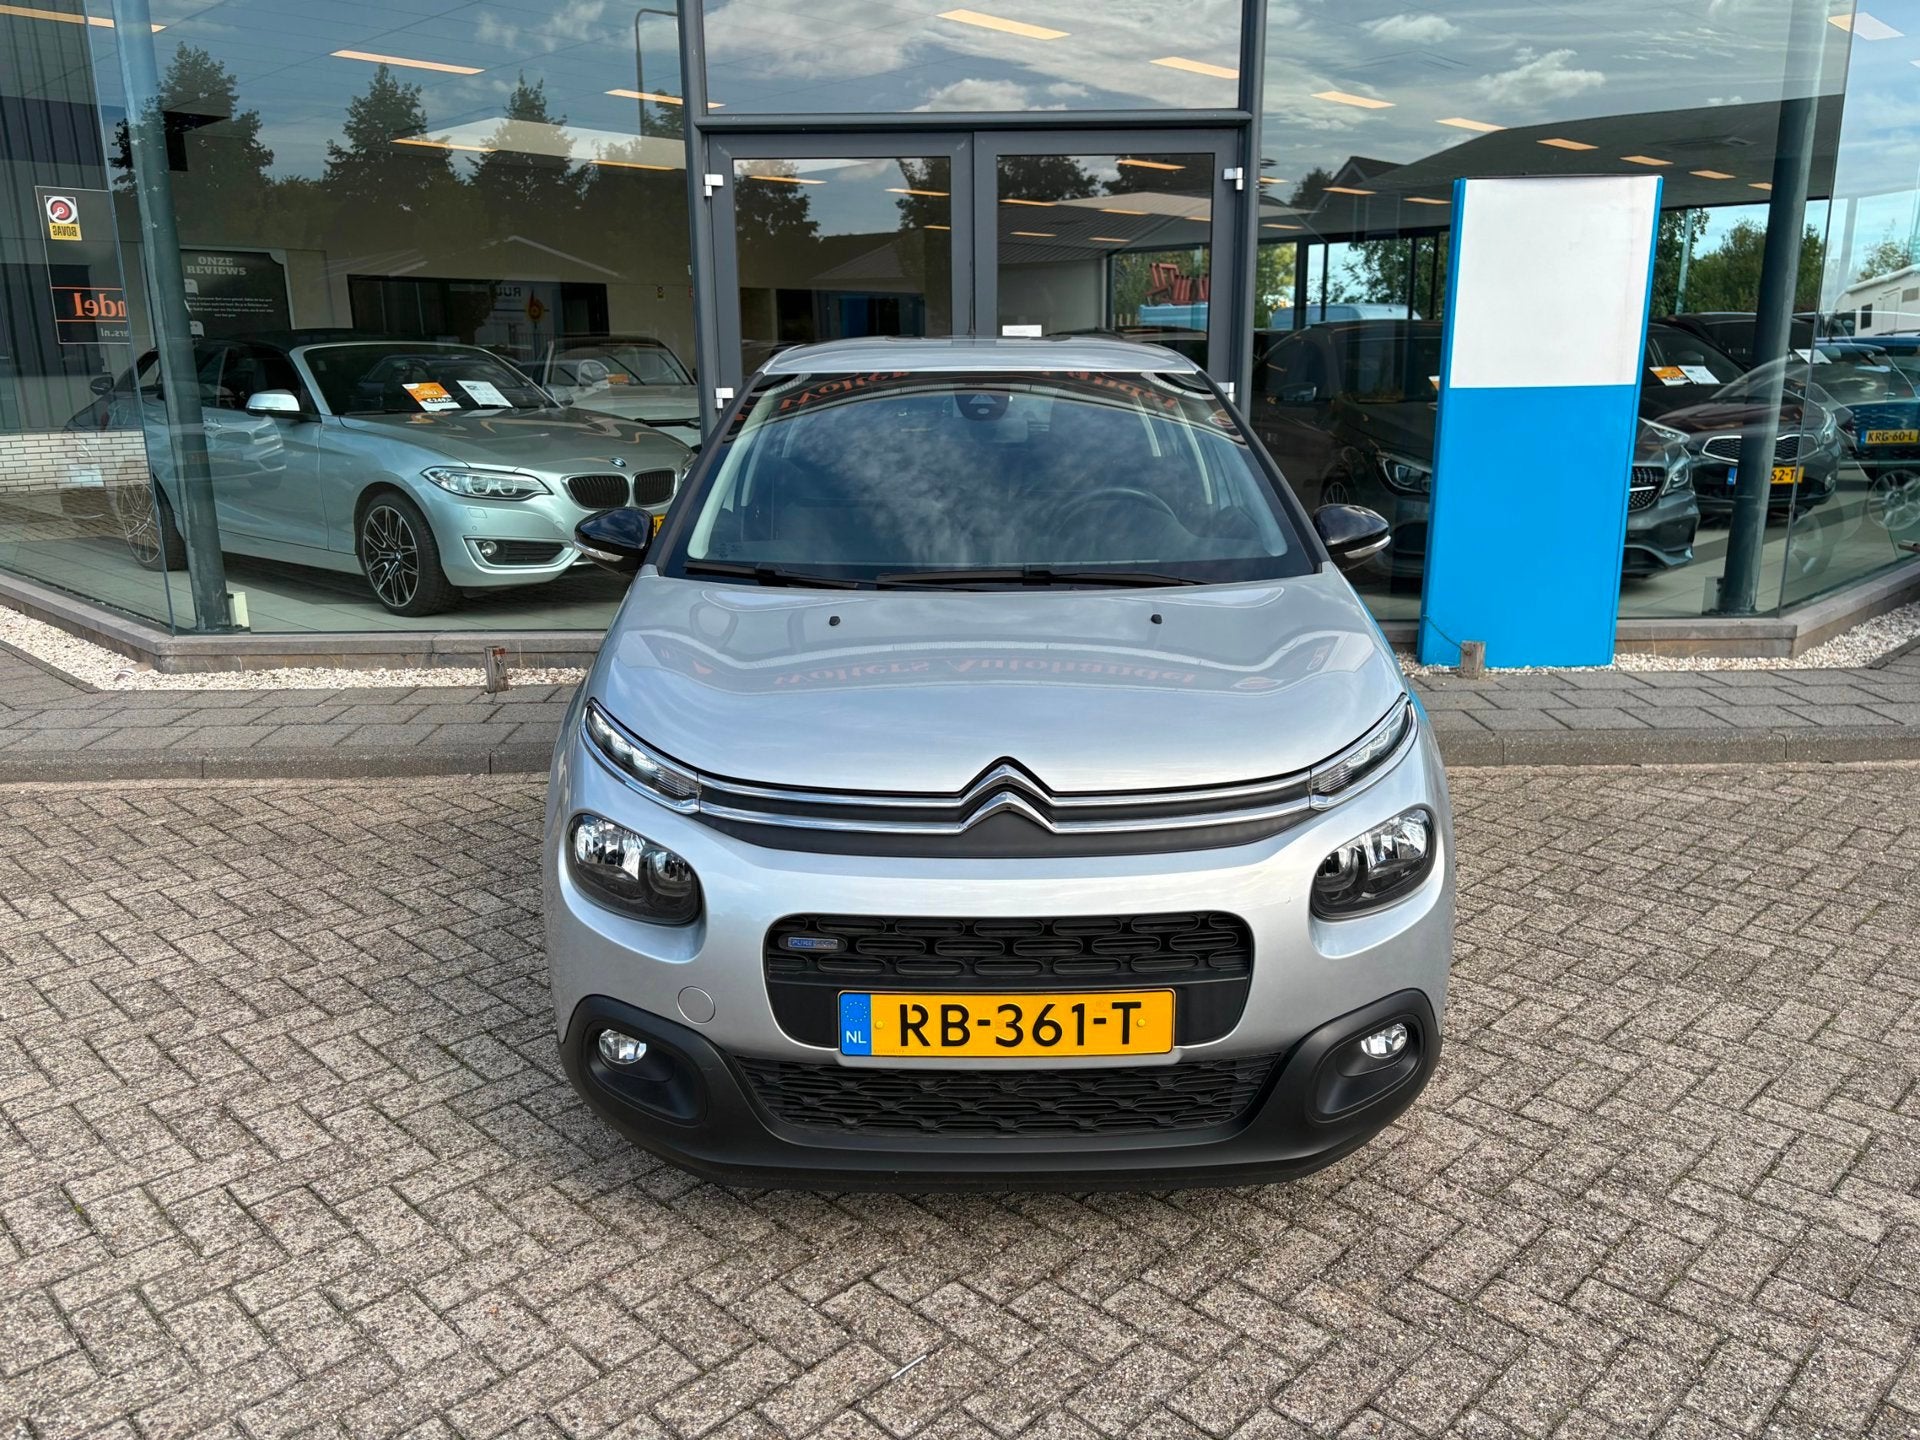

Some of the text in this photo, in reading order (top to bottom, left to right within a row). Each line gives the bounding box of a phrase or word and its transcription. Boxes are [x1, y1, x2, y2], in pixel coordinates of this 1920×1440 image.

[198, 256, 233, 266] ONZE
[187, 265, 247, 276] REVIEWS
[1867, 431, 1914, 442] KRG-60-L
[846, 1001, 1142, 1048] NL RB-361-T
